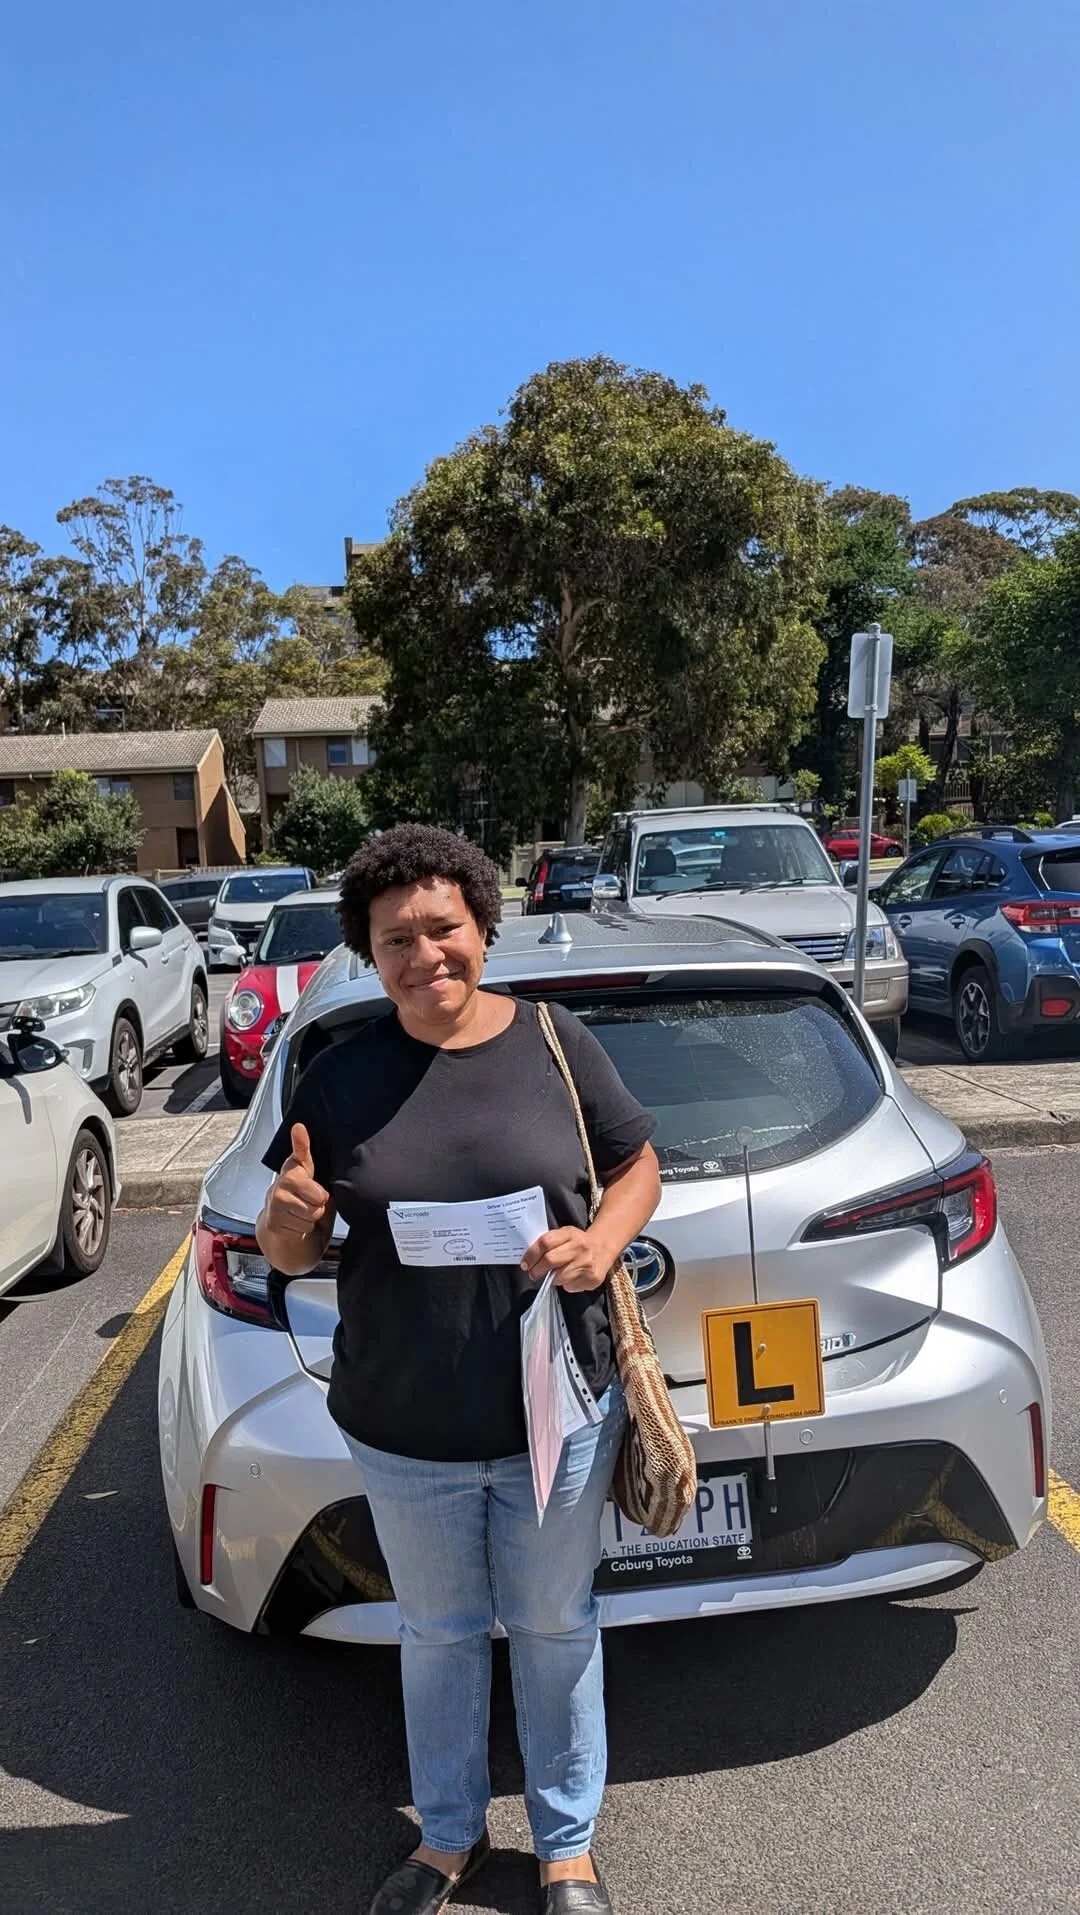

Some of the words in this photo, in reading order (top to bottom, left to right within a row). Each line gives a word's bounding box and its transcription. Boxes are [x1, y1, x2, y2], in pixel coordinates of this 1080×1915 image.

[733, 1321, 795, 1407] L
[673, 1483, 746, 1533] PH
[620, 1544, 641, 1555] THE
[645, 1537, 709, 1552] EDUCATION
[712, 1533, 745, 1545] STATE
[611, 1560, 653, 1572] Coburg
[656, 1555, 693, 1568] Toyota
